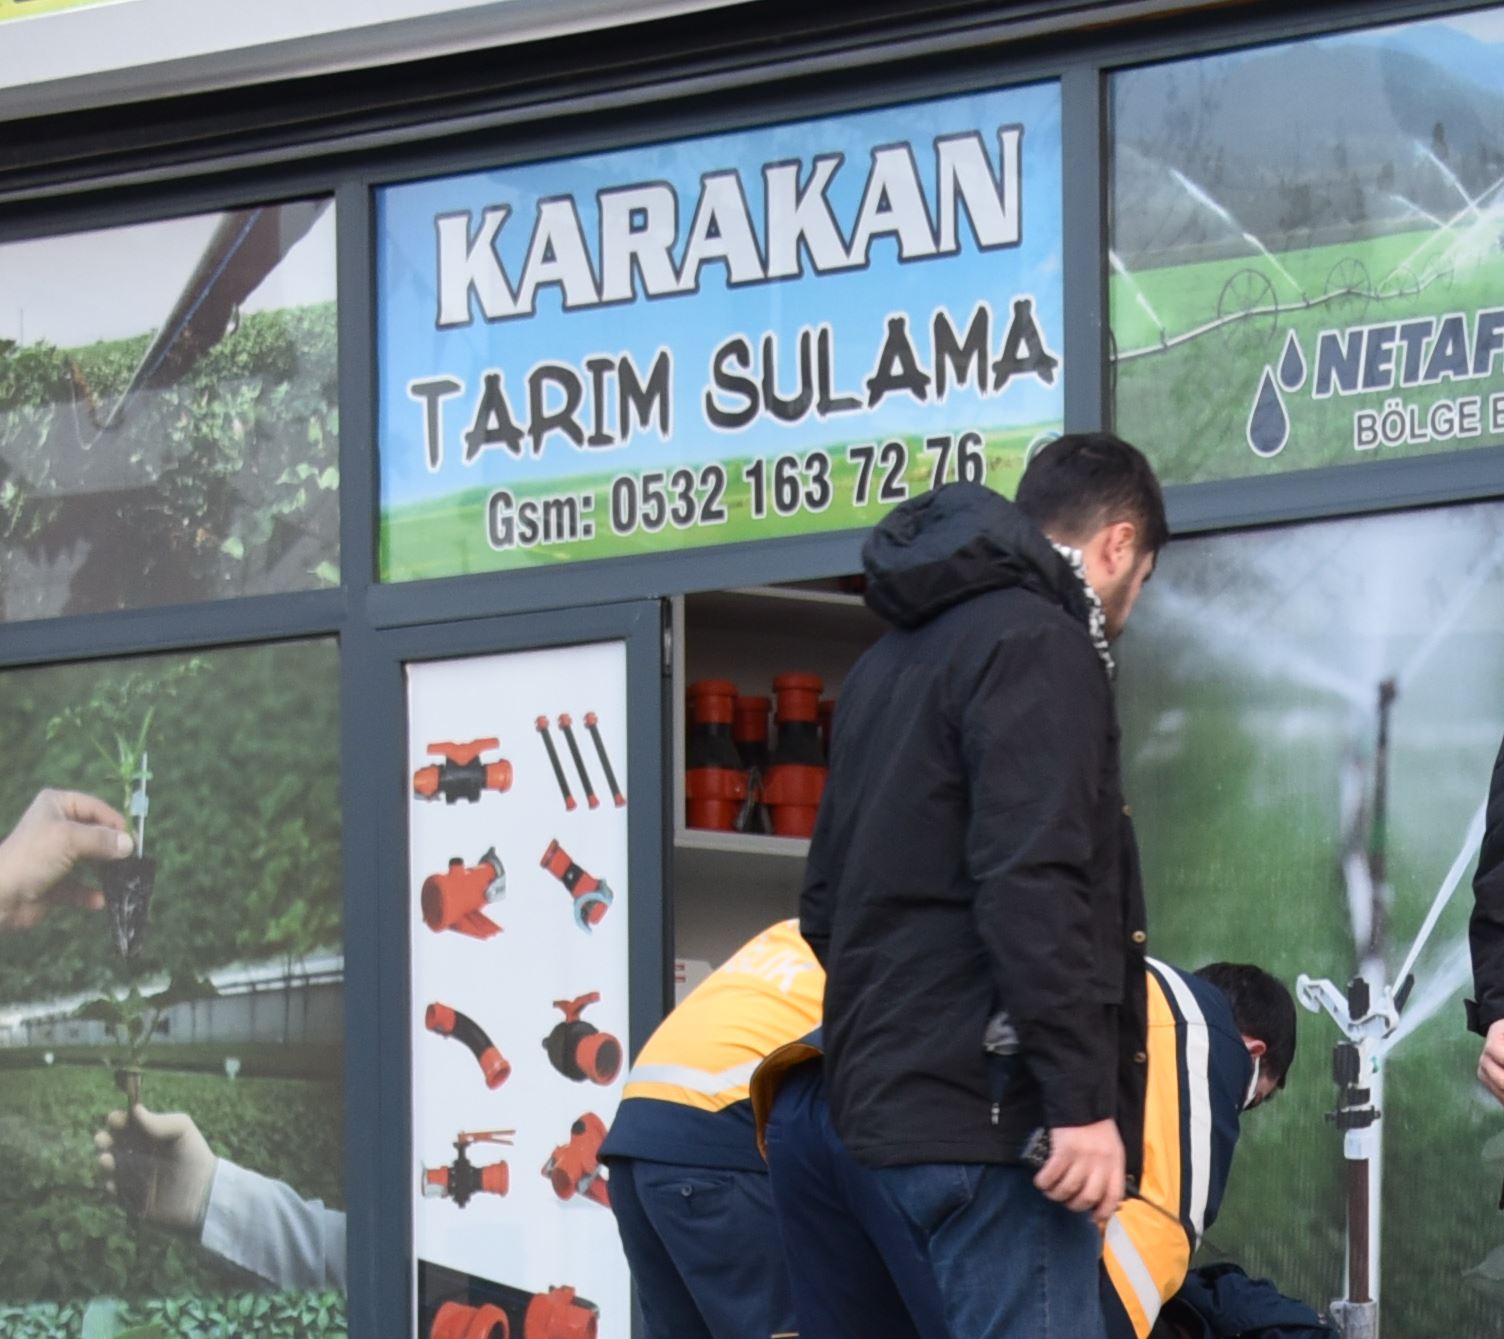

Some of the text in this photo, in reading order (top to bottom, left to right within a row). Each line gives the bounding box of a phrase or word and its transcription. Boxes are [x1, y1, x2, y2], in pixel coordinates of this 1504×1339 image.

[434, 124, 1024, 329] KARAKAN
[410, 297, 1059, 470] TARIM SULAMA
[1356, 399, 1480, 449] BÖLGE
[488, 433, 985, 549] Gsm: 0532 163 72 76
